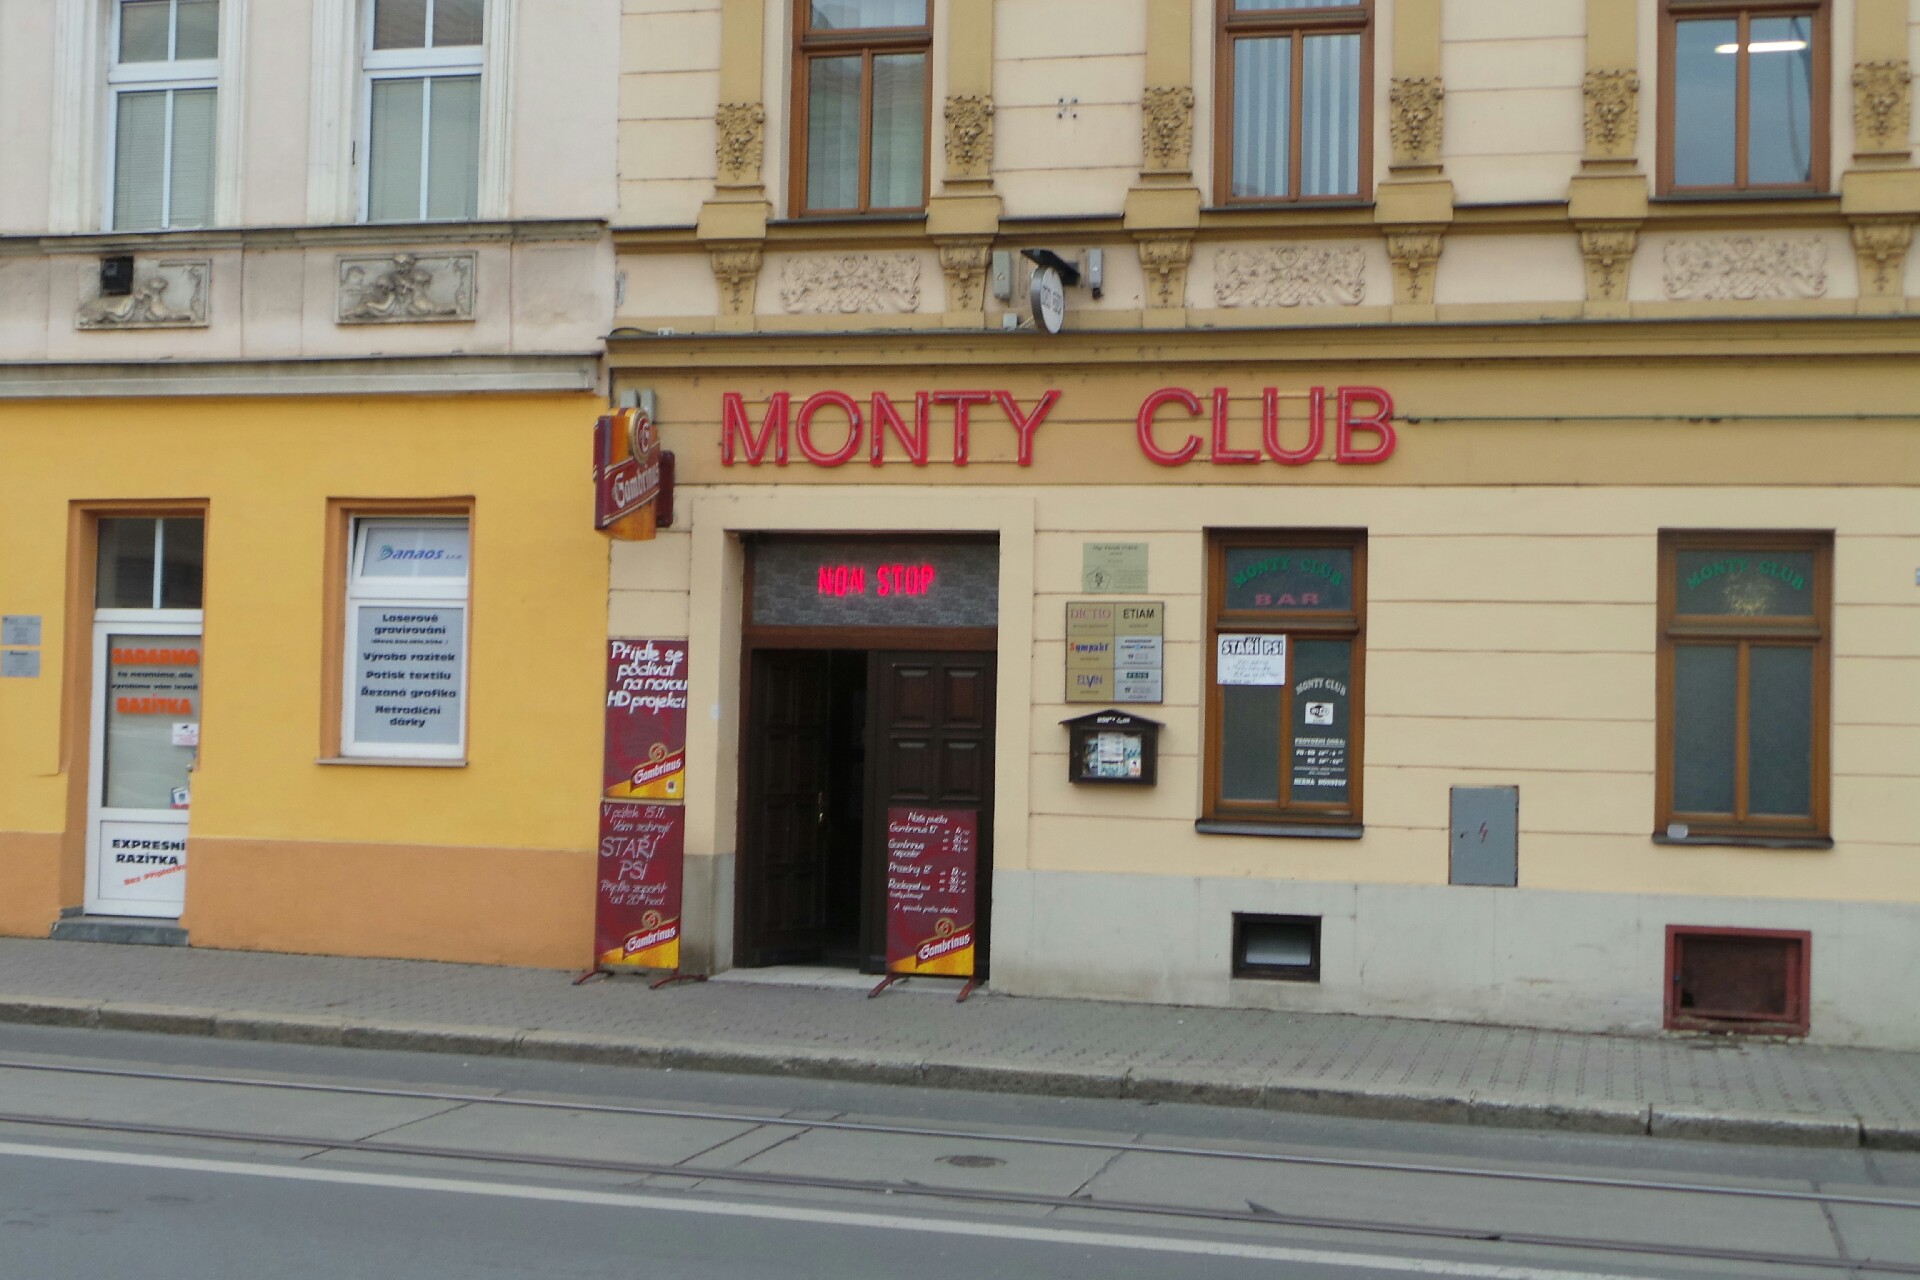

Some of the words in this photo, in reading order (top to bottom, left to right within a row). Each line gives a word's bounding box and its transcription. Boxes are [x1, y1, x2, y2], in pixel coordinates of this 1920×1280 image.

[721, 389, 1062, 467] MONTY
[1137, 386, 1397, 467] CLUB
[817, 565, 865, 598] NON
[876, 564, 936, 597] STOP
[1232, 556, 1292, 589] MONTY
[1300, 557, 1344, 586] CLUB
[1687, 557, 1749, 590] MONTY
[1758, 560, 1805, 590] CLUB
[1255, 592, 1319, 606] BAR
[1123, 608, 1155, 620] ETIAM
[366, 671, 405, 679] Potisk
[606, 689, 631, 708] HD
[632, 757, 682, 786] Gambrinus
[112, 839, 186, 851] EXPRESNÍ
[115, 852, 179, 865] RAZÍTKA
[625, 926, 677, 953] Gambrinus
[918, 933, 971, 960] Gambrinus
